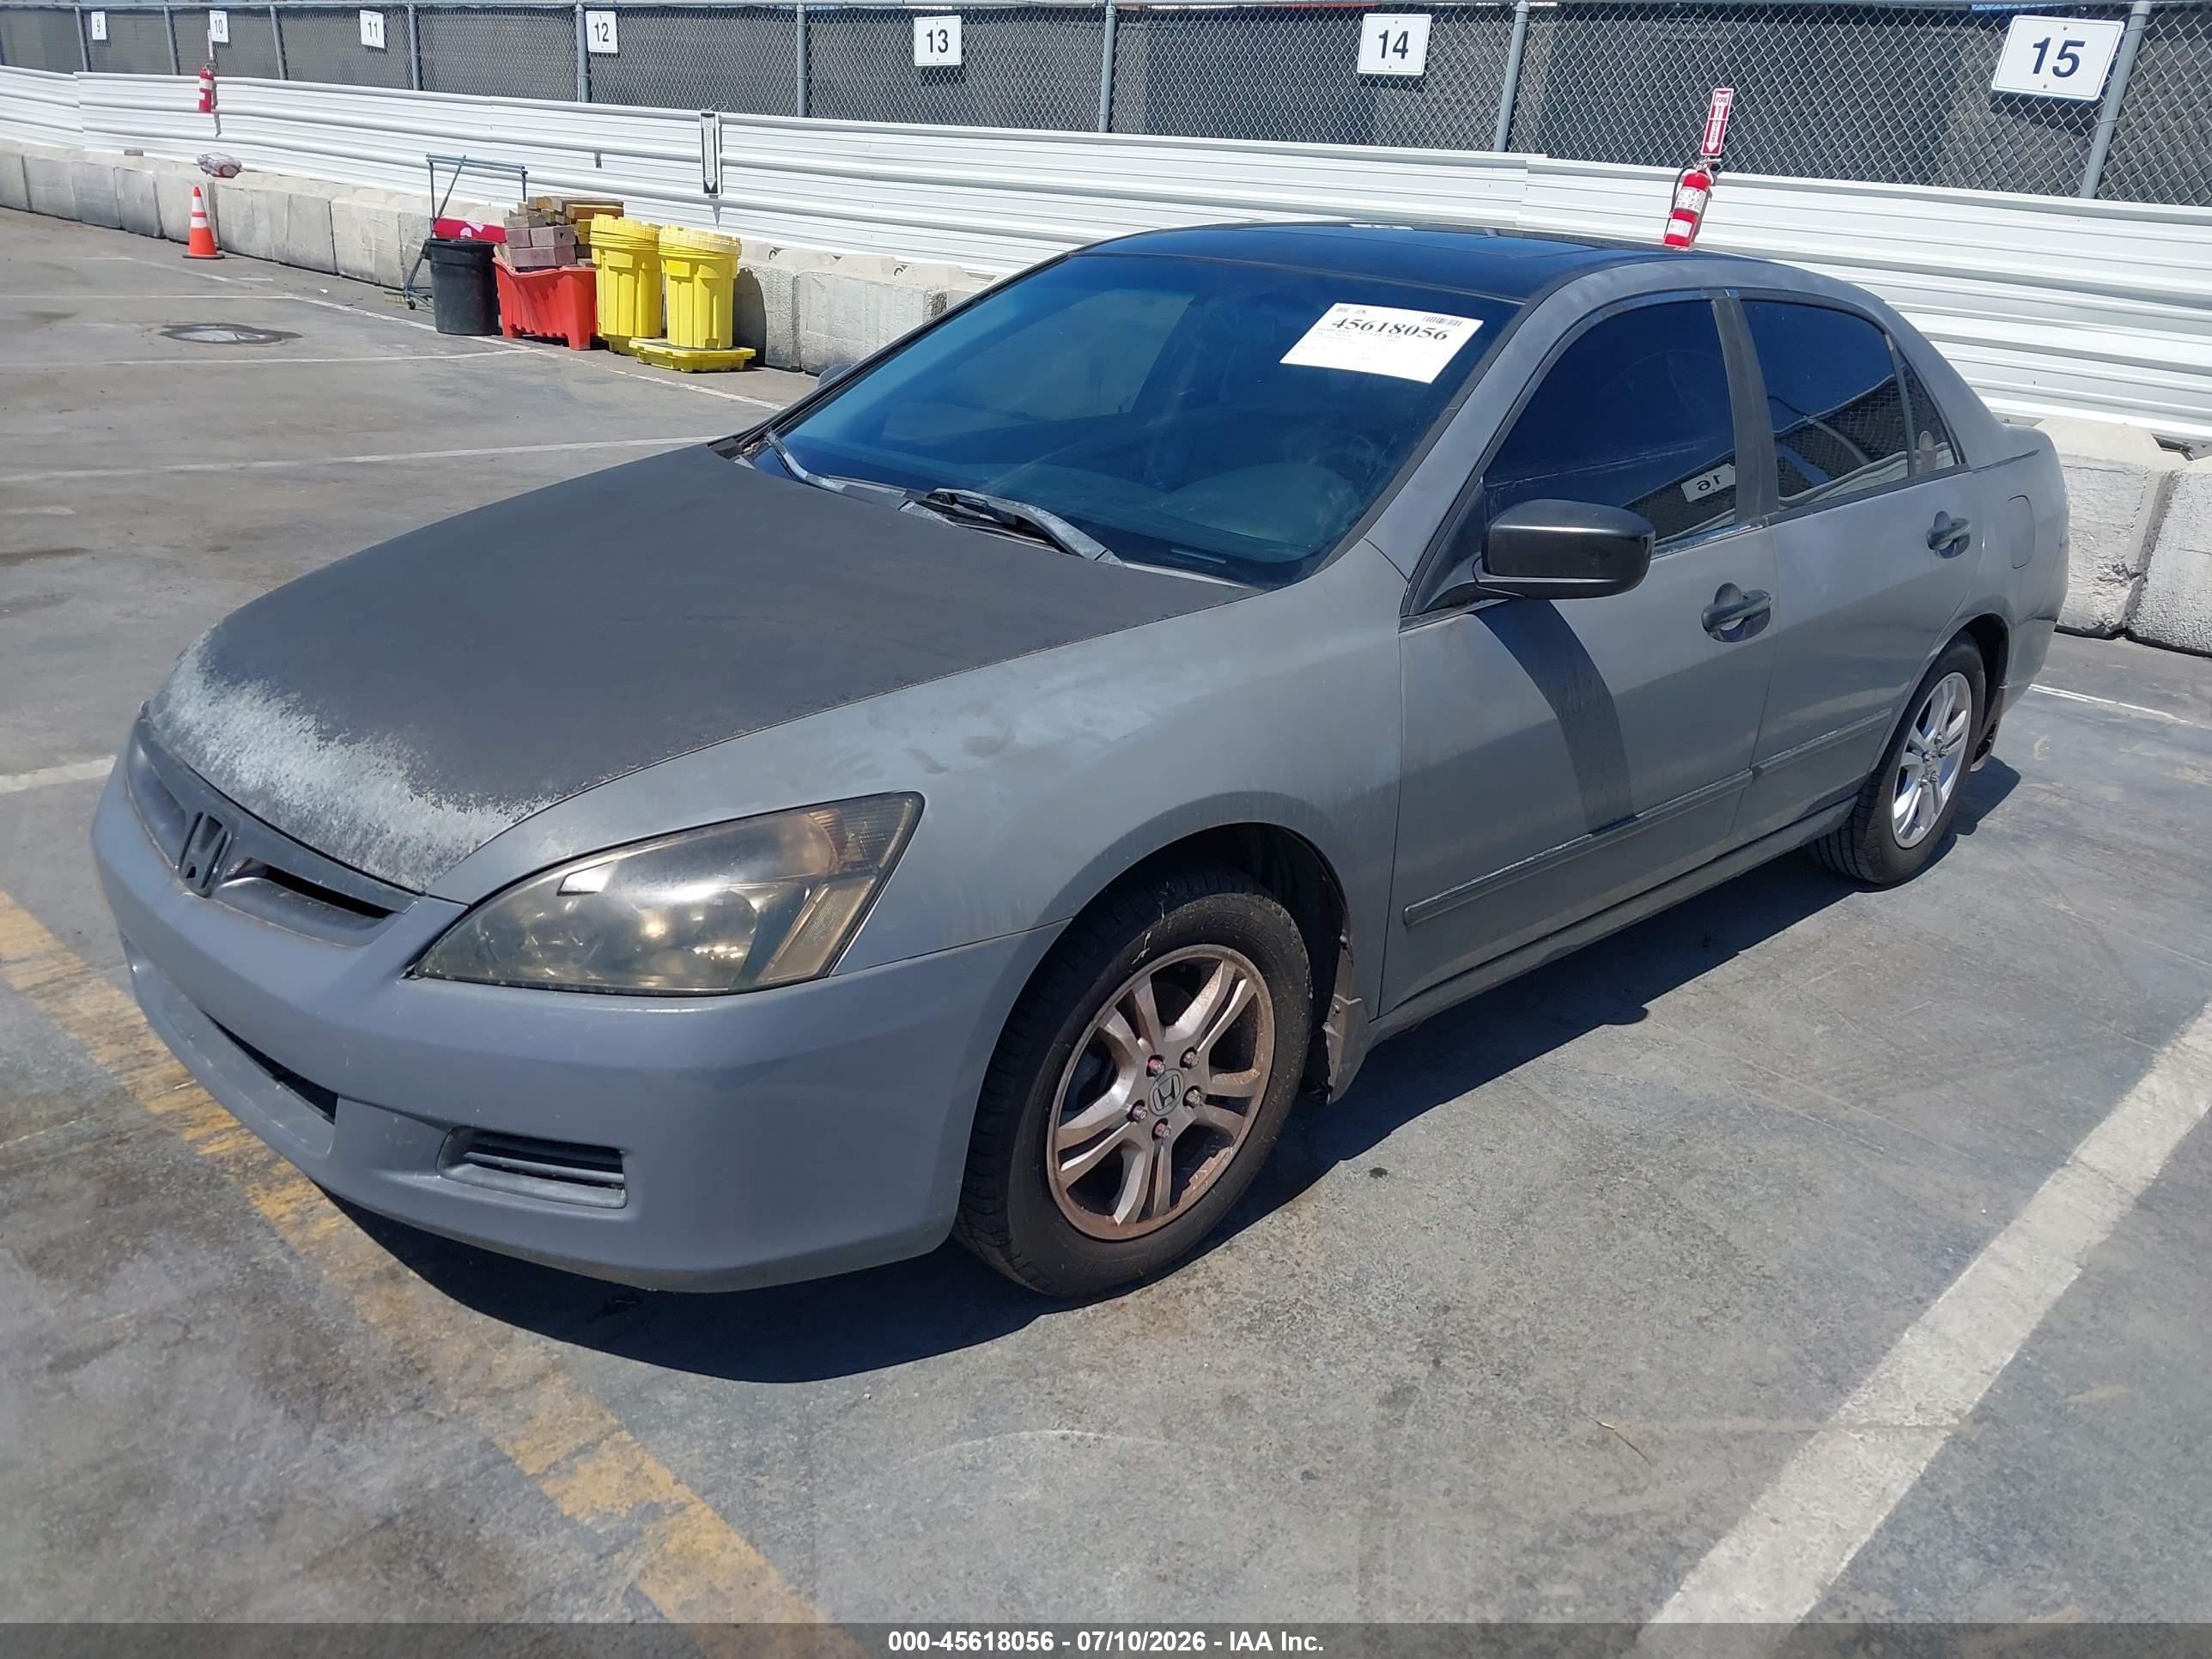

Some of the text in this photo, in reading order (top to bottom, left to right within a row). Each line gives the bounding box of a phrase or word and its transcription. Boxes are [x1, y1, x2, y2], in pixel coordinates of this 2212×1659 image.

[96, 18, 101, 33] 9
[214, 18, 223, 34] 10
[368, 20, 379, 38] 11
[594, 21, 610, 42] 12
[927, 28, 949, 53] 13
[1378, 29, 1409, 59] 14
[2033, 37, 2086, 78] 15
[1332, 317, 1451, 341] 45618056
